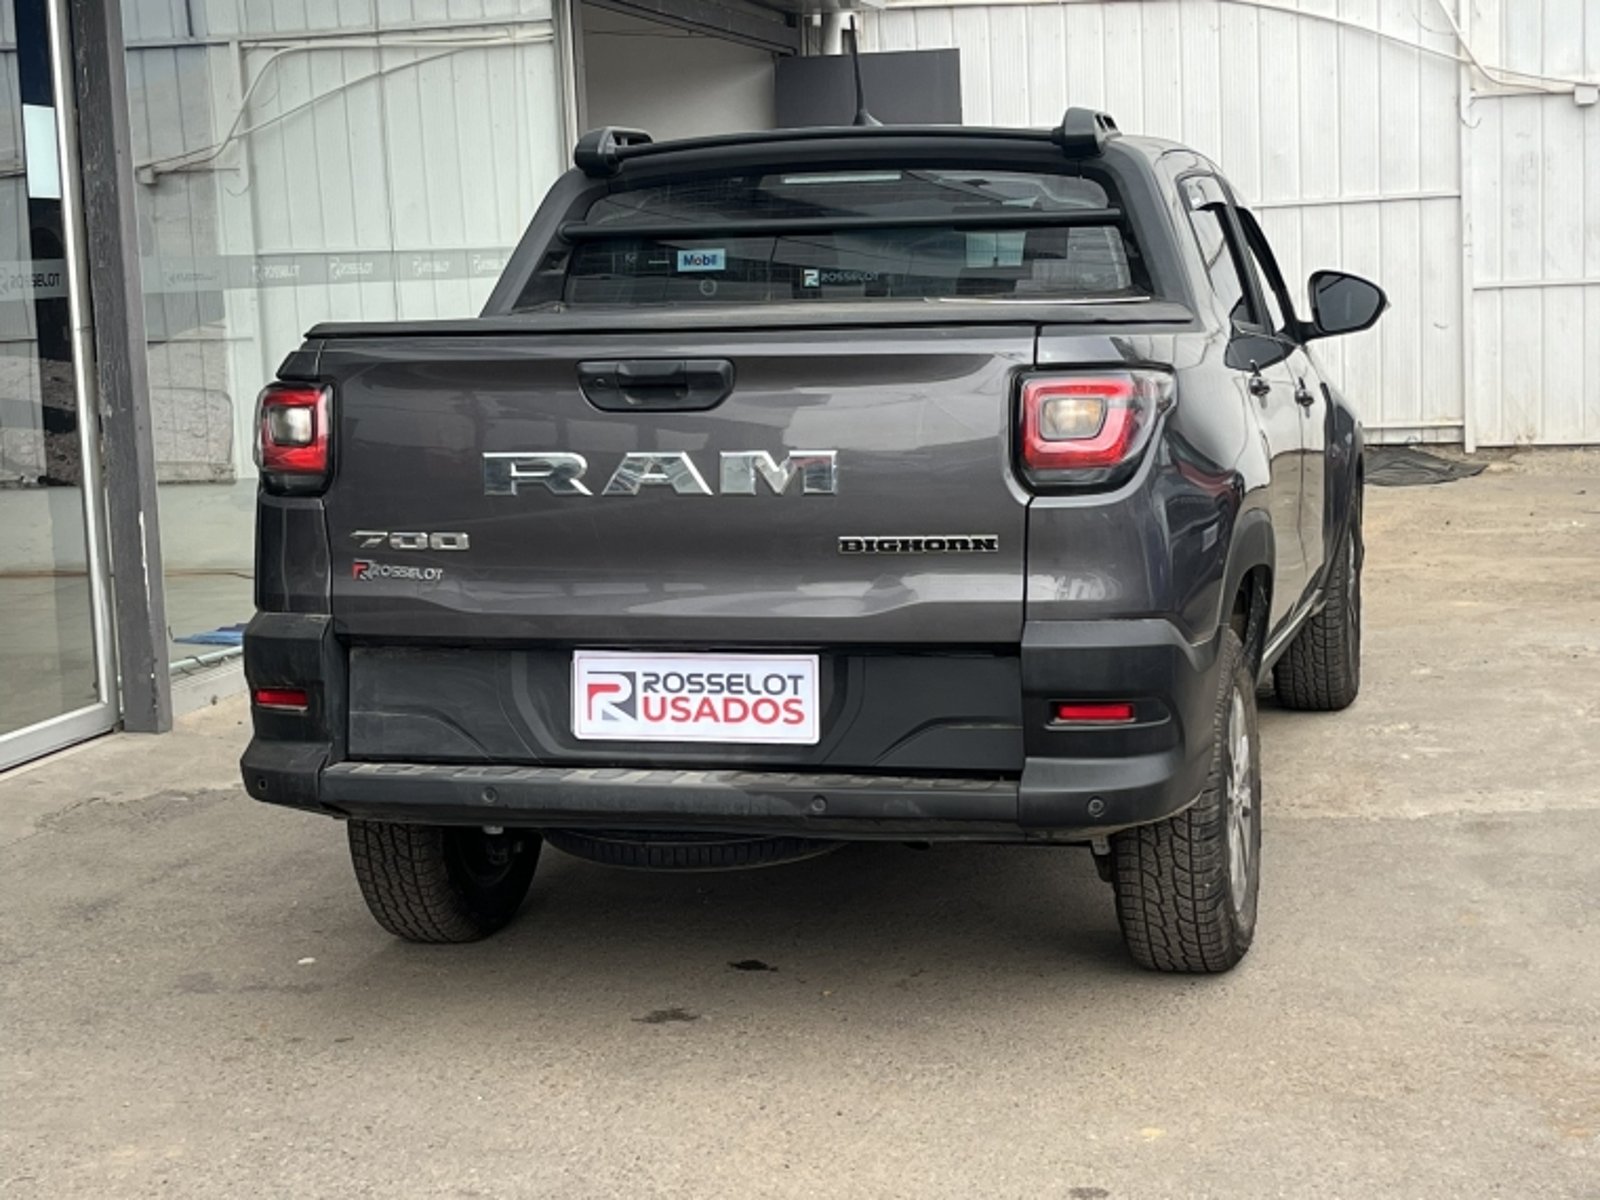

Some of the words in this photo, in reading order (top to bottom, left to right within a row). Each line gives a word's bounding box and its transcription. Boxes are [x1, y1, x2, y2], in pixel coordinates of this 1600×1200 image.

[683, 254, 717, 266] Mobil
[482, 450, 838, 496] RAM
[349, 530, 470, 550] 700
[838, 535, 999, 554] BIGHORN
[369, 564, 443, 580] ROSSELOT
[642, 672, 804, 695] ROSSELOT
[643, 696, 805, 725] USADOS
